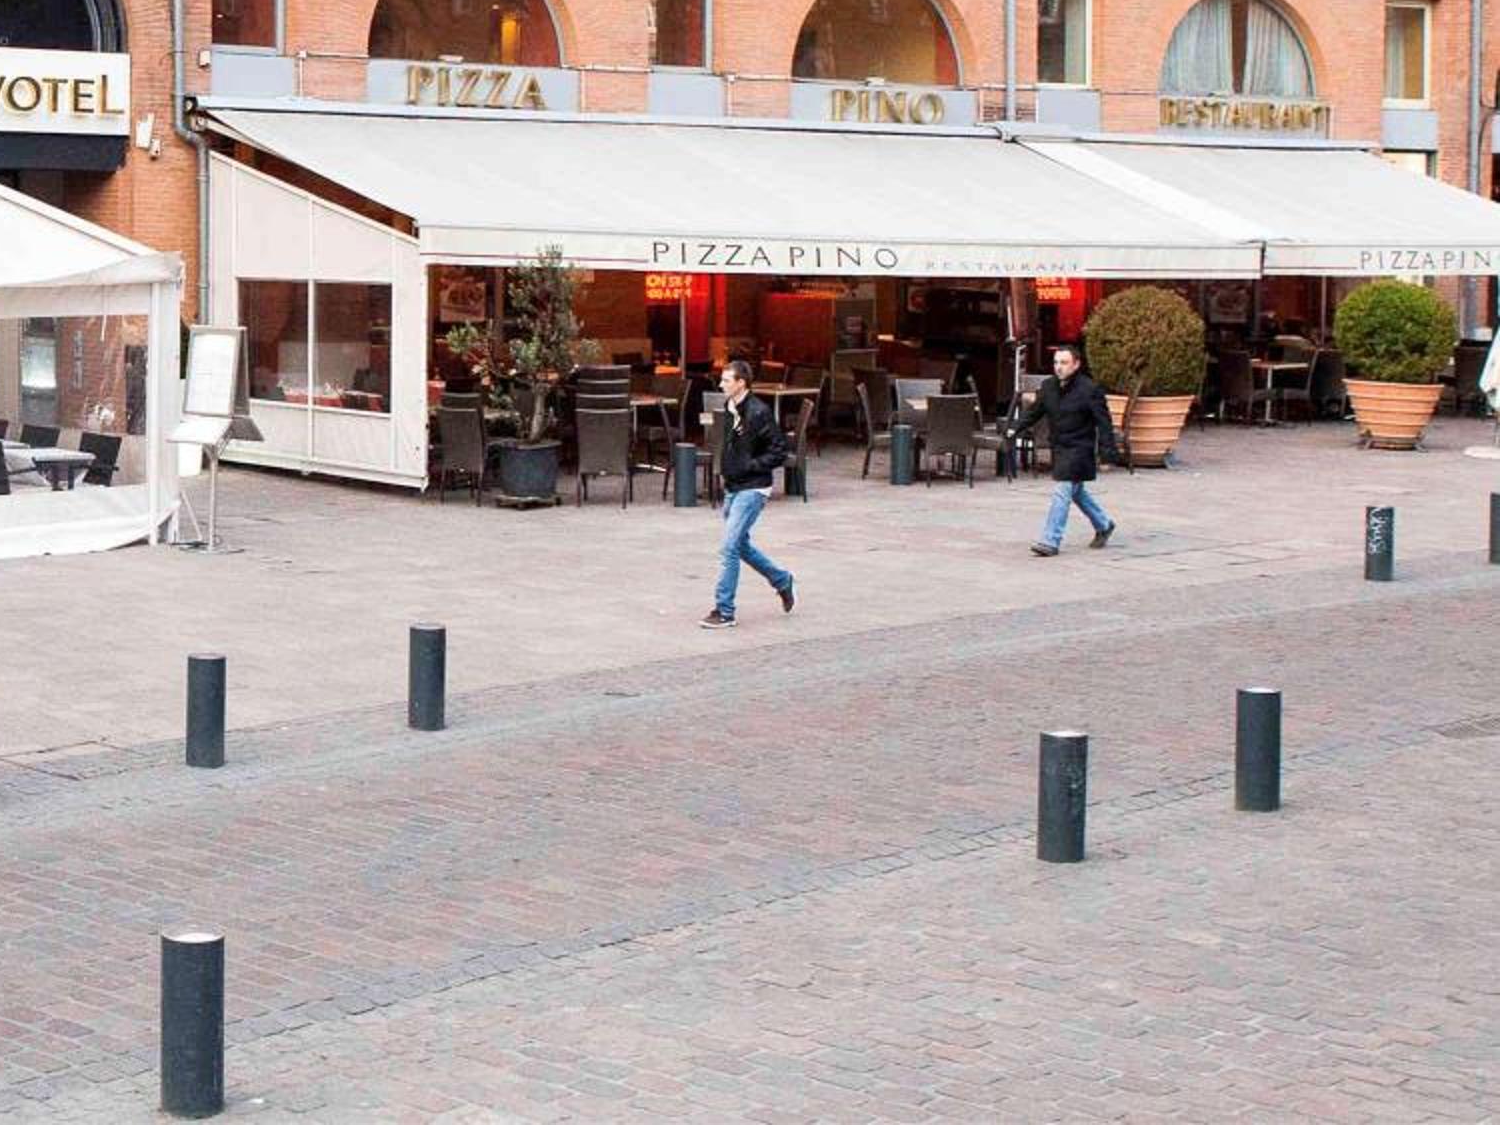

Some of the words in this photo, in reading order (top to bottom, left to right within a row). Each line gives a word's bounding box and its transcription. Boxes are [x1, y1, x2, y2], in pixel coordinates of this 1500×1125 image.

[406, 64, 547, 111] PIZZA
[830, 89, 946, 125] PINO
[1158, 97, 1326, 131] RESTAURANT
[652, 241, 773, 266] PIZZA
[789, 245, 899, 270] PINO
[1442, 249, 1500, 270] PIN
